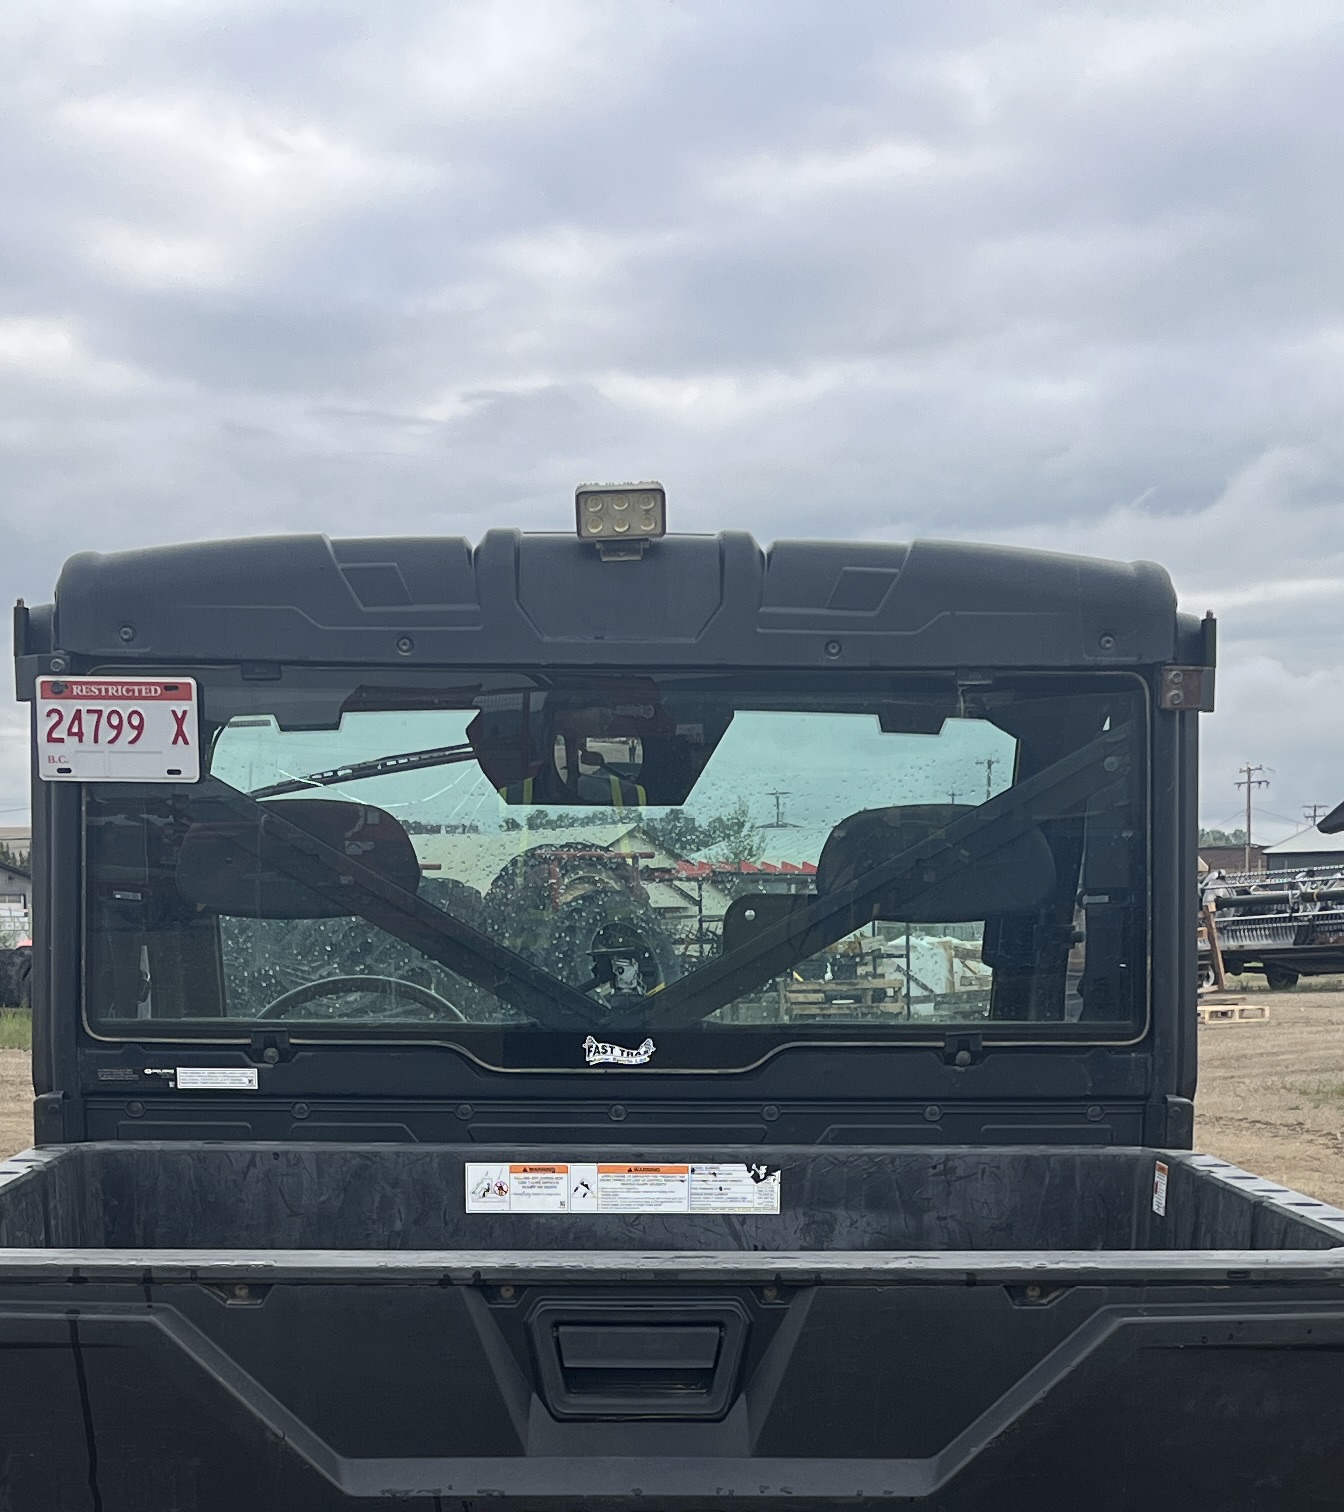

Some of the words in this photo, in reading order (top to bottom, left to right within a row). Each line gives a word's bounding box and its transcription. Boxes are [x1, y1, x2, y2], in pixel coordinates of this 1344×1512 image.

[72, 685, 161, 697] RESTRICTED
[46, 708, 145, 745] 24799
[171, 710, 190, 746] X
[47, 755, 69, 764] B.C.
[587, 1044, 616, 1058] FAST
